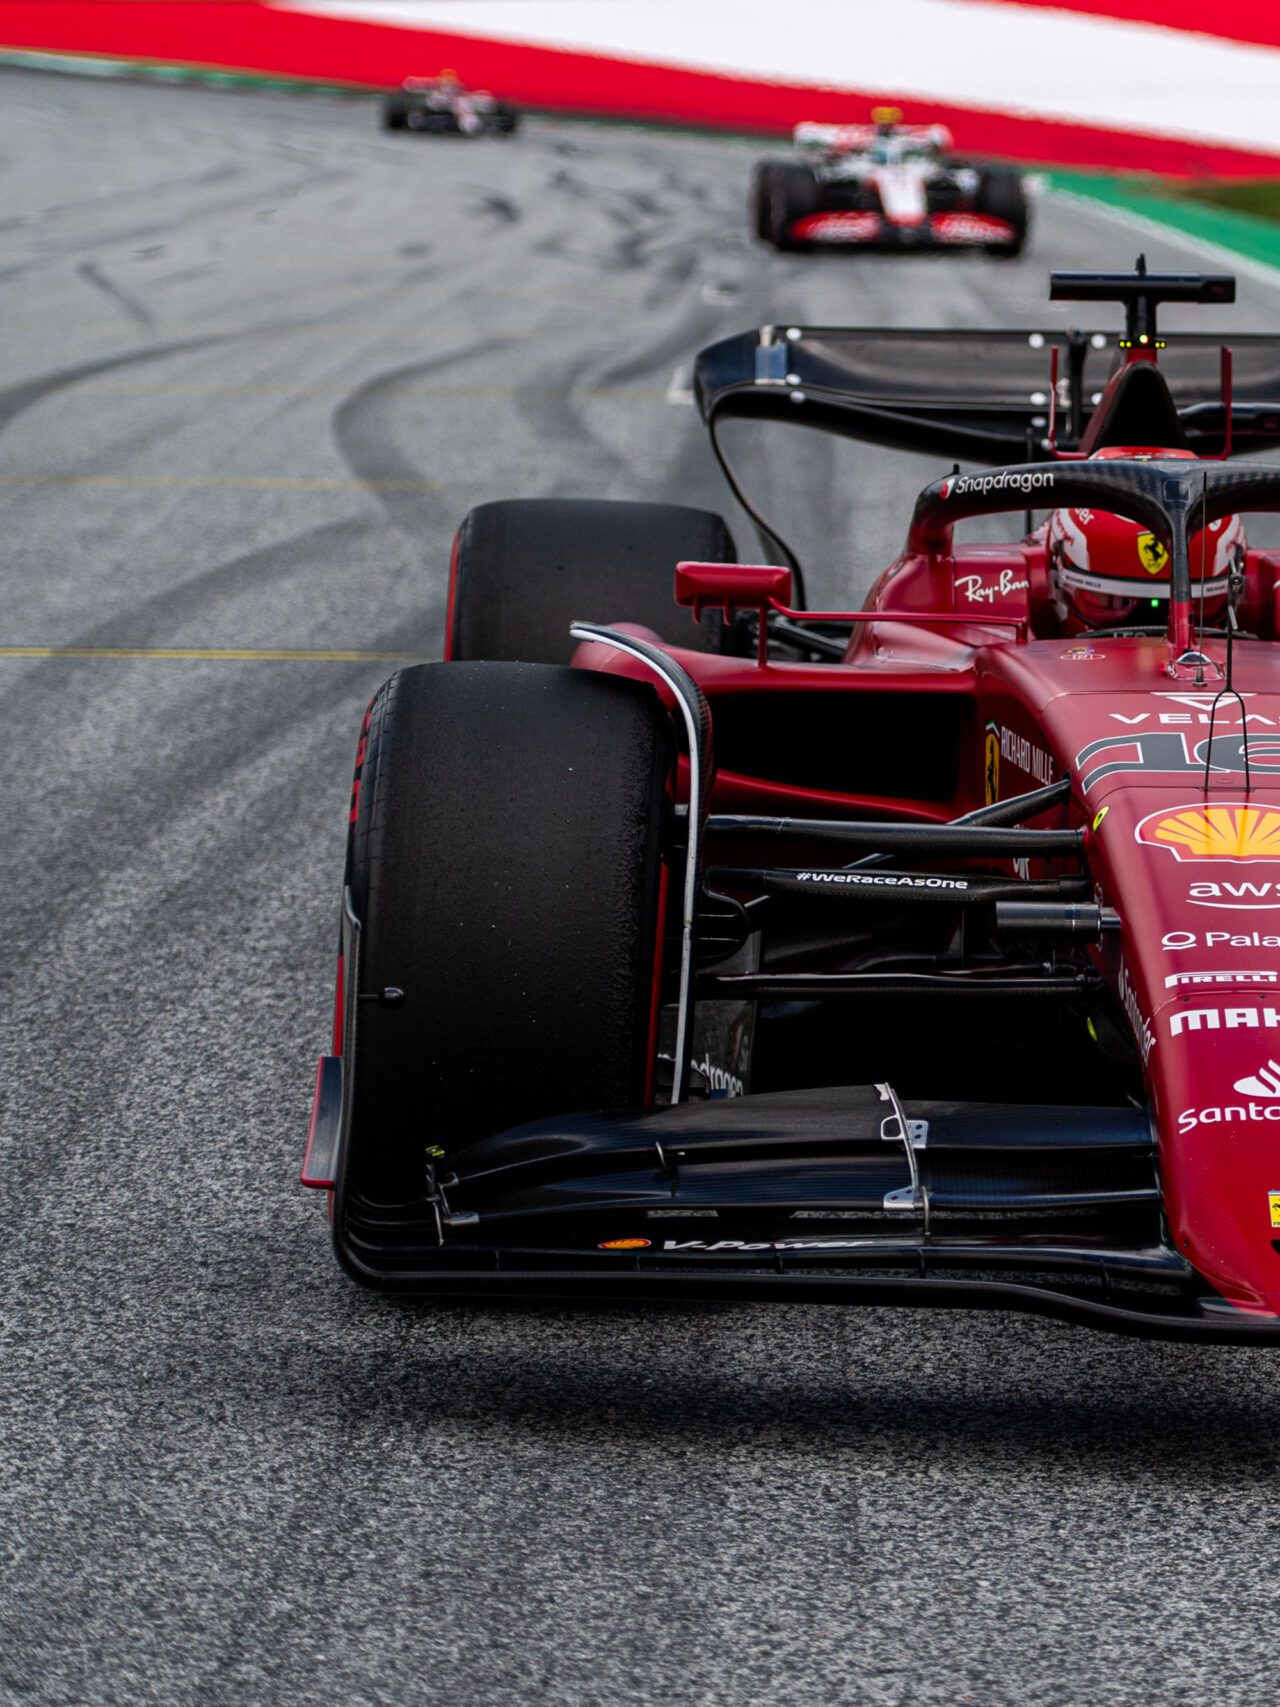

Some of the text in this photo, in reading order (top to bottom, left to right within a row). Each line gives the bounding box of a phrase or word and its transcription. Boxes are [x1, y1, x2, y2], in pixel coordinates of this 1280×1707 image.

[955, 471, 1055, 495] Snapdragon
[1001, 725, 1054, 786] RICHARD MILLE
[796, 872, 969, 890] #WeRaceAsOne
[1164, 970, 1278, 989] PIRELLI
[663, 1239, 874, 1251] V-Power
